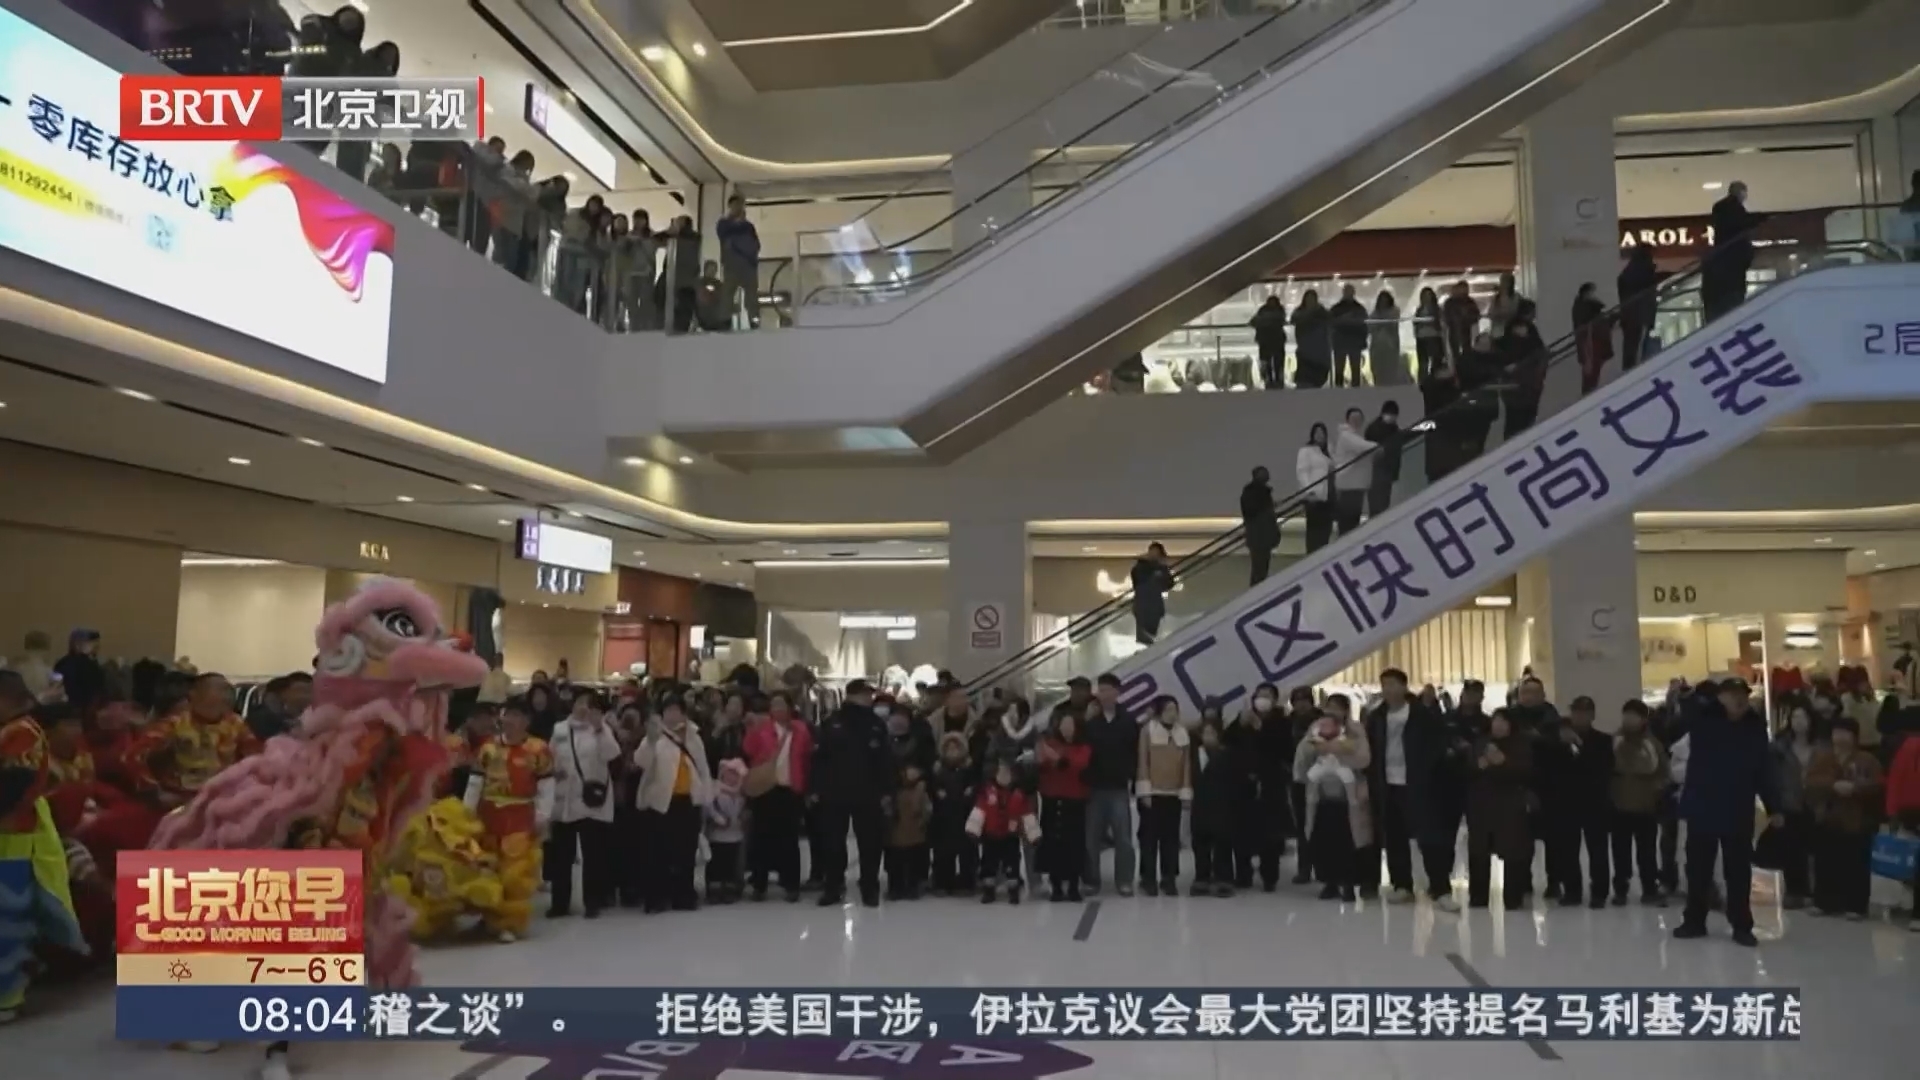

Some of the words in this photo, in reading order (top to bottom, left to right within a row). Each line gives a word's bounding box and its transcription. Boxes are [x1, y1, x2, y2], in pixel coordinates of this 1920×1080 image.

[28, 93, 236, 222] 零库存放心拿
